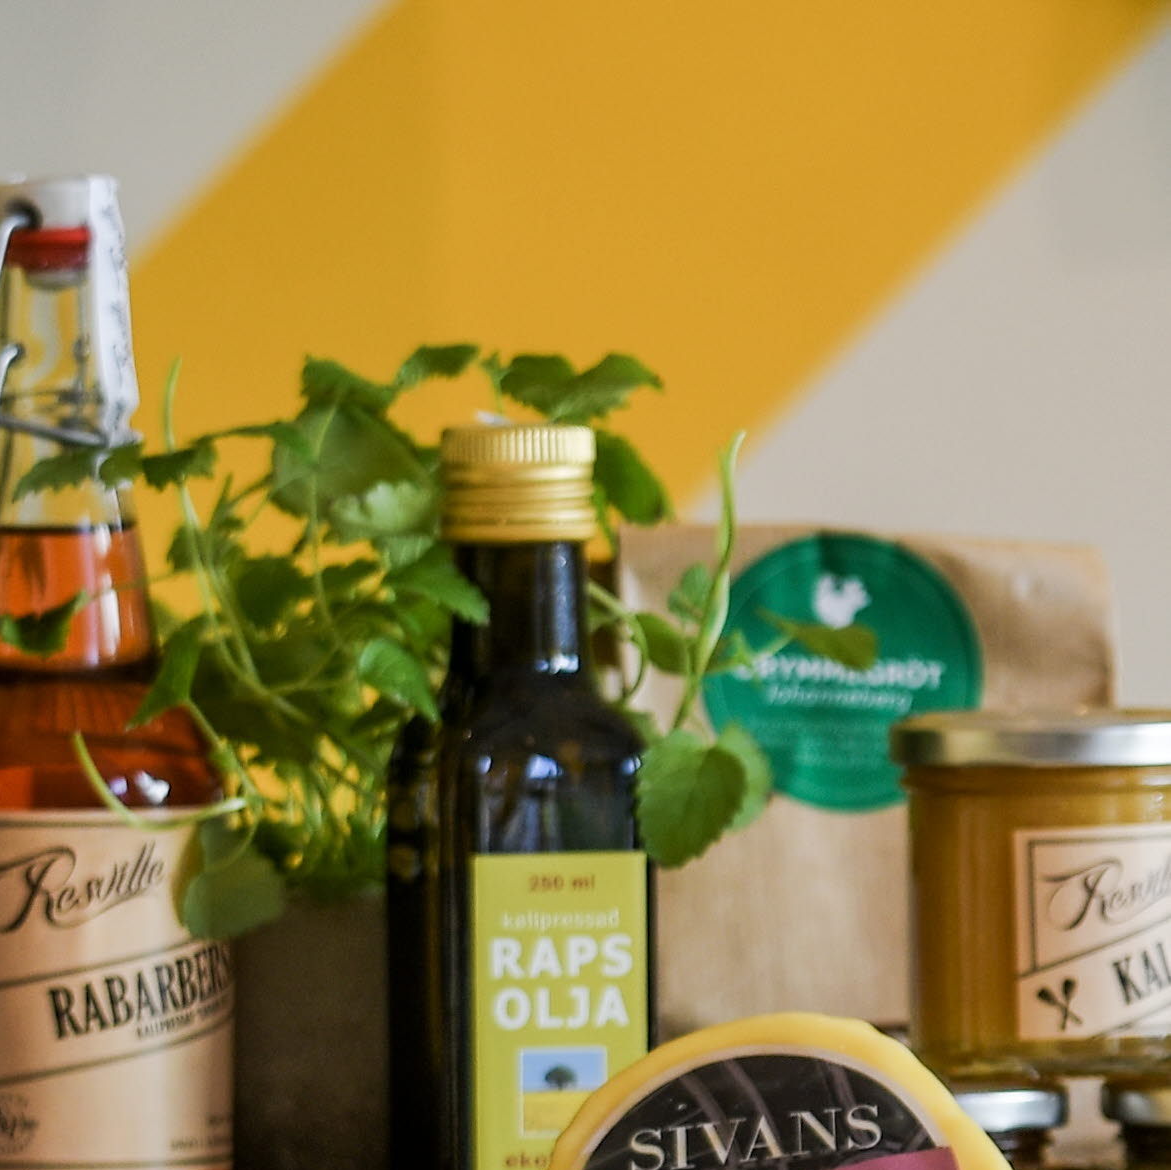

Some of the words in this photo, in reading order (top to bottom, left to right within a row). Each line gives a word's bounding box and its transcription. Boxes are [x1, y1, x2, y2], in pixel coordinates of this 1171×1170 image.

[571, 875, 595, 890] ml
[501, 909, 620, 931] kallpressad
[489, 934, 633, 980] RAPS
[494, 986, 630, 1031] OLJA
